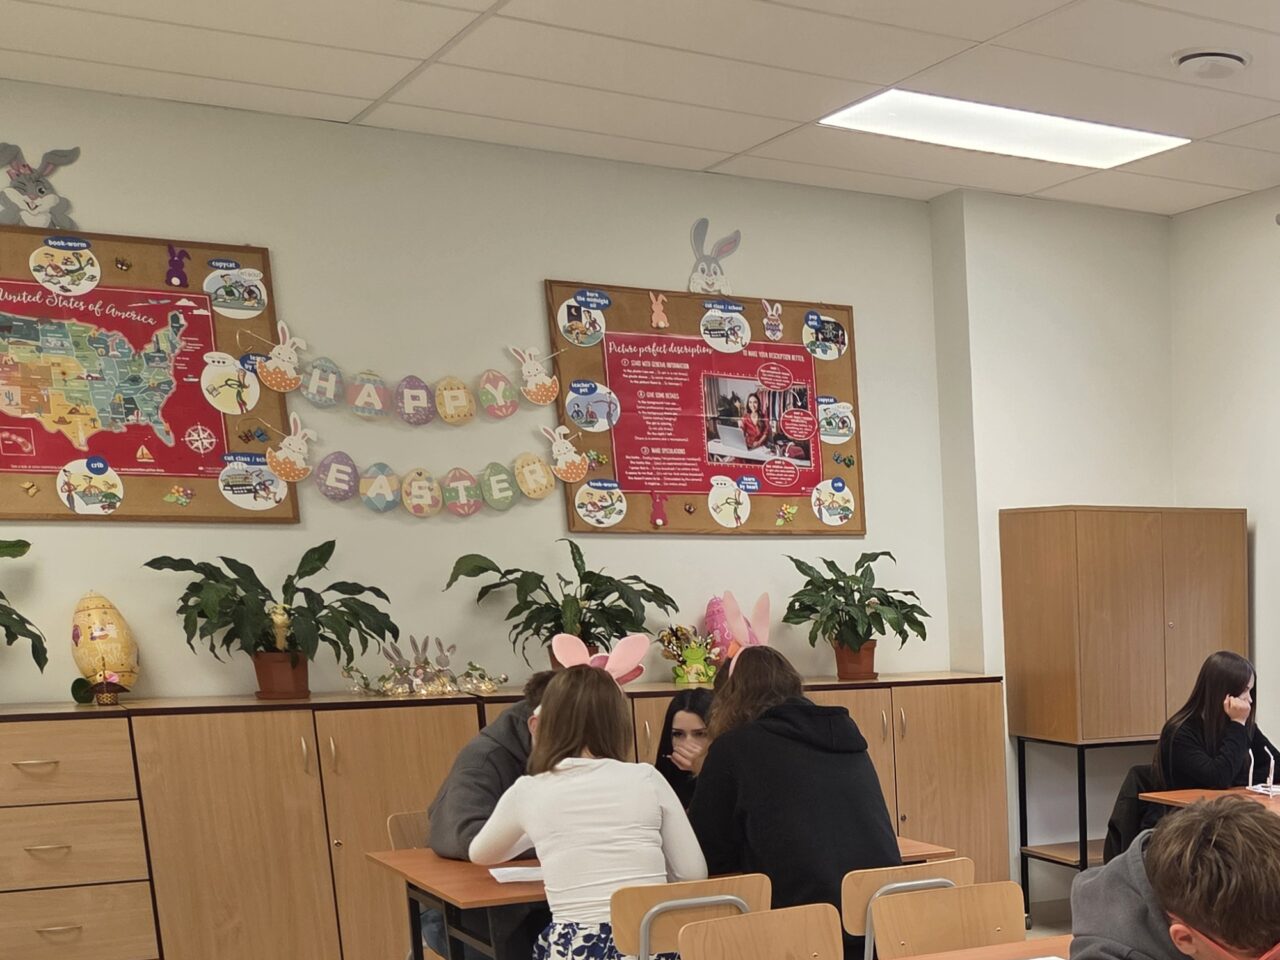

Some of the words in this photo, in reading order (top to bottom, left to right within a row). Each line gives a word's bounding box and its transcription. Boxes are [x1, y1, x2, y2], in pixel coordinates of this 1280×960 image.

[48, 239, 87, 248] book-worm
[212, 261, 236, 269] copycat
[0, 287, 43, 304] United
[46, 292, 86, 310] States
[88, 302, 104, 317] of
[105, 305, 157, 326] America
[608, 341, 638, 354] Picture
[638, 342, 667, 357] perfect
[668, 342, 713, 358] description
[307, 367, 507, 413] HAPPY
[326, 462, 548, 506] EASTER
